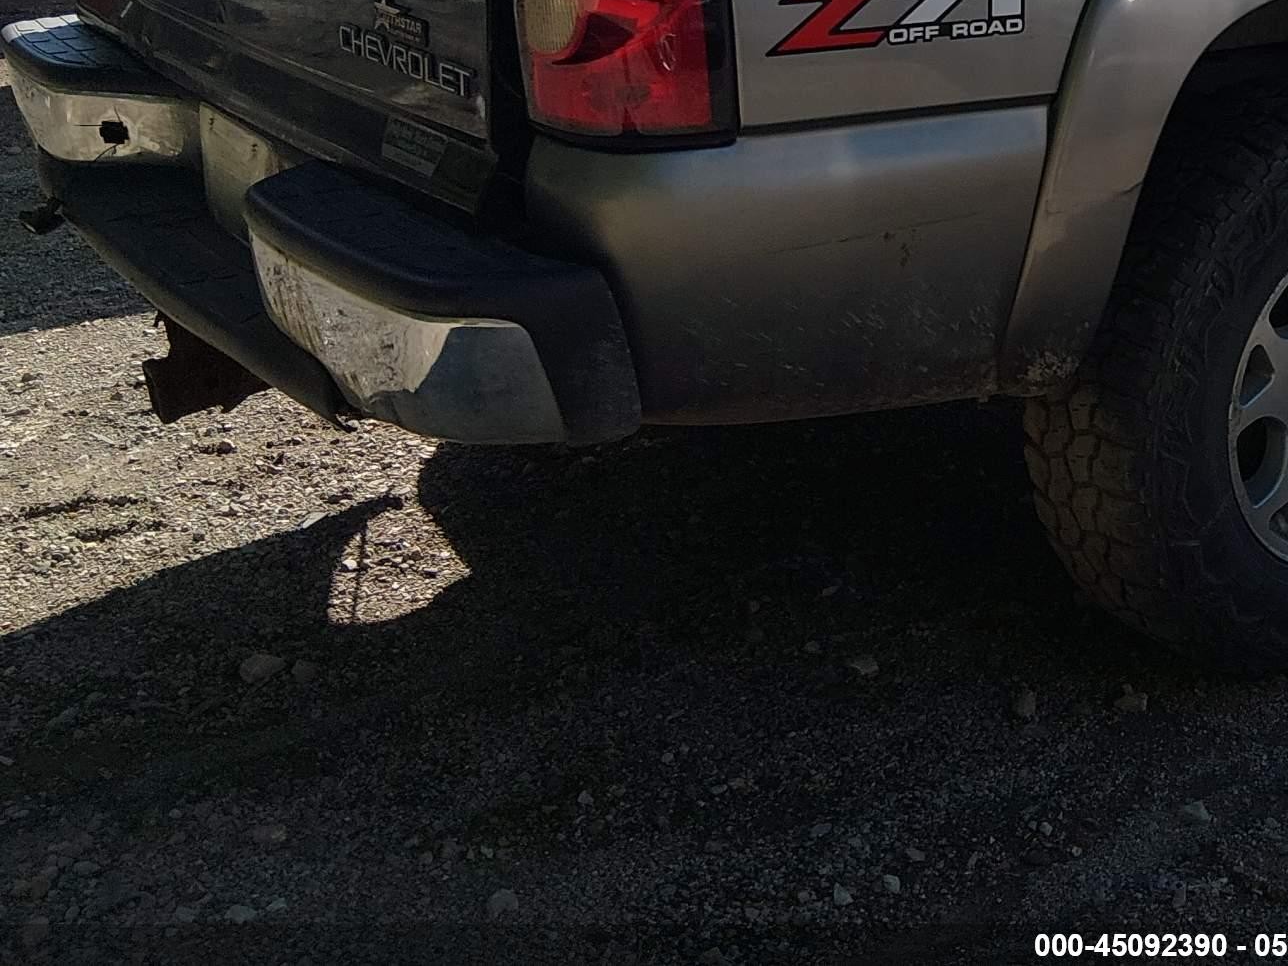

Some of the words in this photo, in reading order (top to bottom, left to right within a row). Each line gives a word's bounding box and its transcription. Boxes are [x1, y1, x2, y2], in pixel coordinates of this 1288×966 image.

[889, 28, 940, 44] OFF
[950, 18, 1024, 39] ROAD
[339, 25, 473, 97] CHEVROLET
